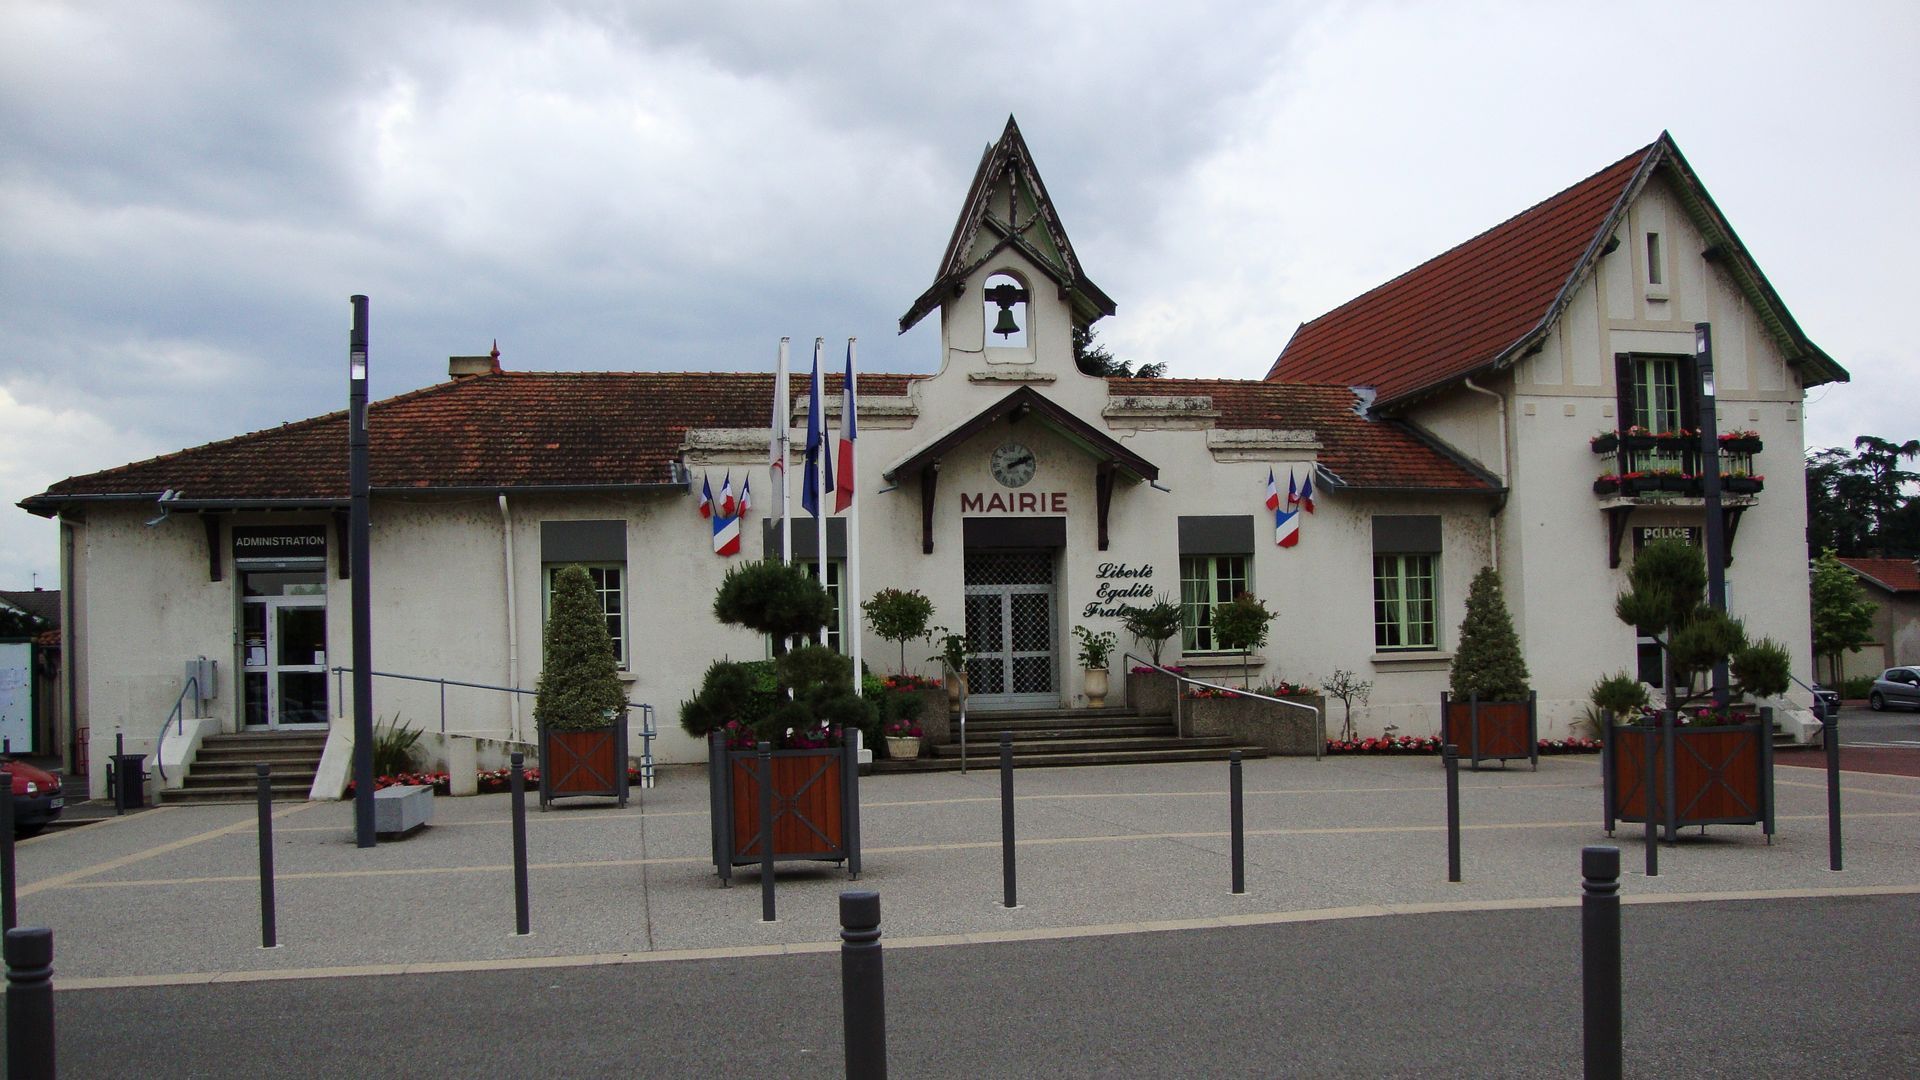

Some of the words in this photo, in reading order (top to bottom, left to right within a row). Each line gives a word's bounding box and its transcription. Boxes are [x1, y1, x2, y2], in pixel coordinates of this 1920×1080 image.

[961, 492, 1067, 513] MAIRIE
[236, 536, 325, 546] ADMINISTRATION
[1643, 528, 1690, 539] POLICE
[1096, 562, 1153, 579] Liberté
[1096, 582, 1153, 604] Egalité
